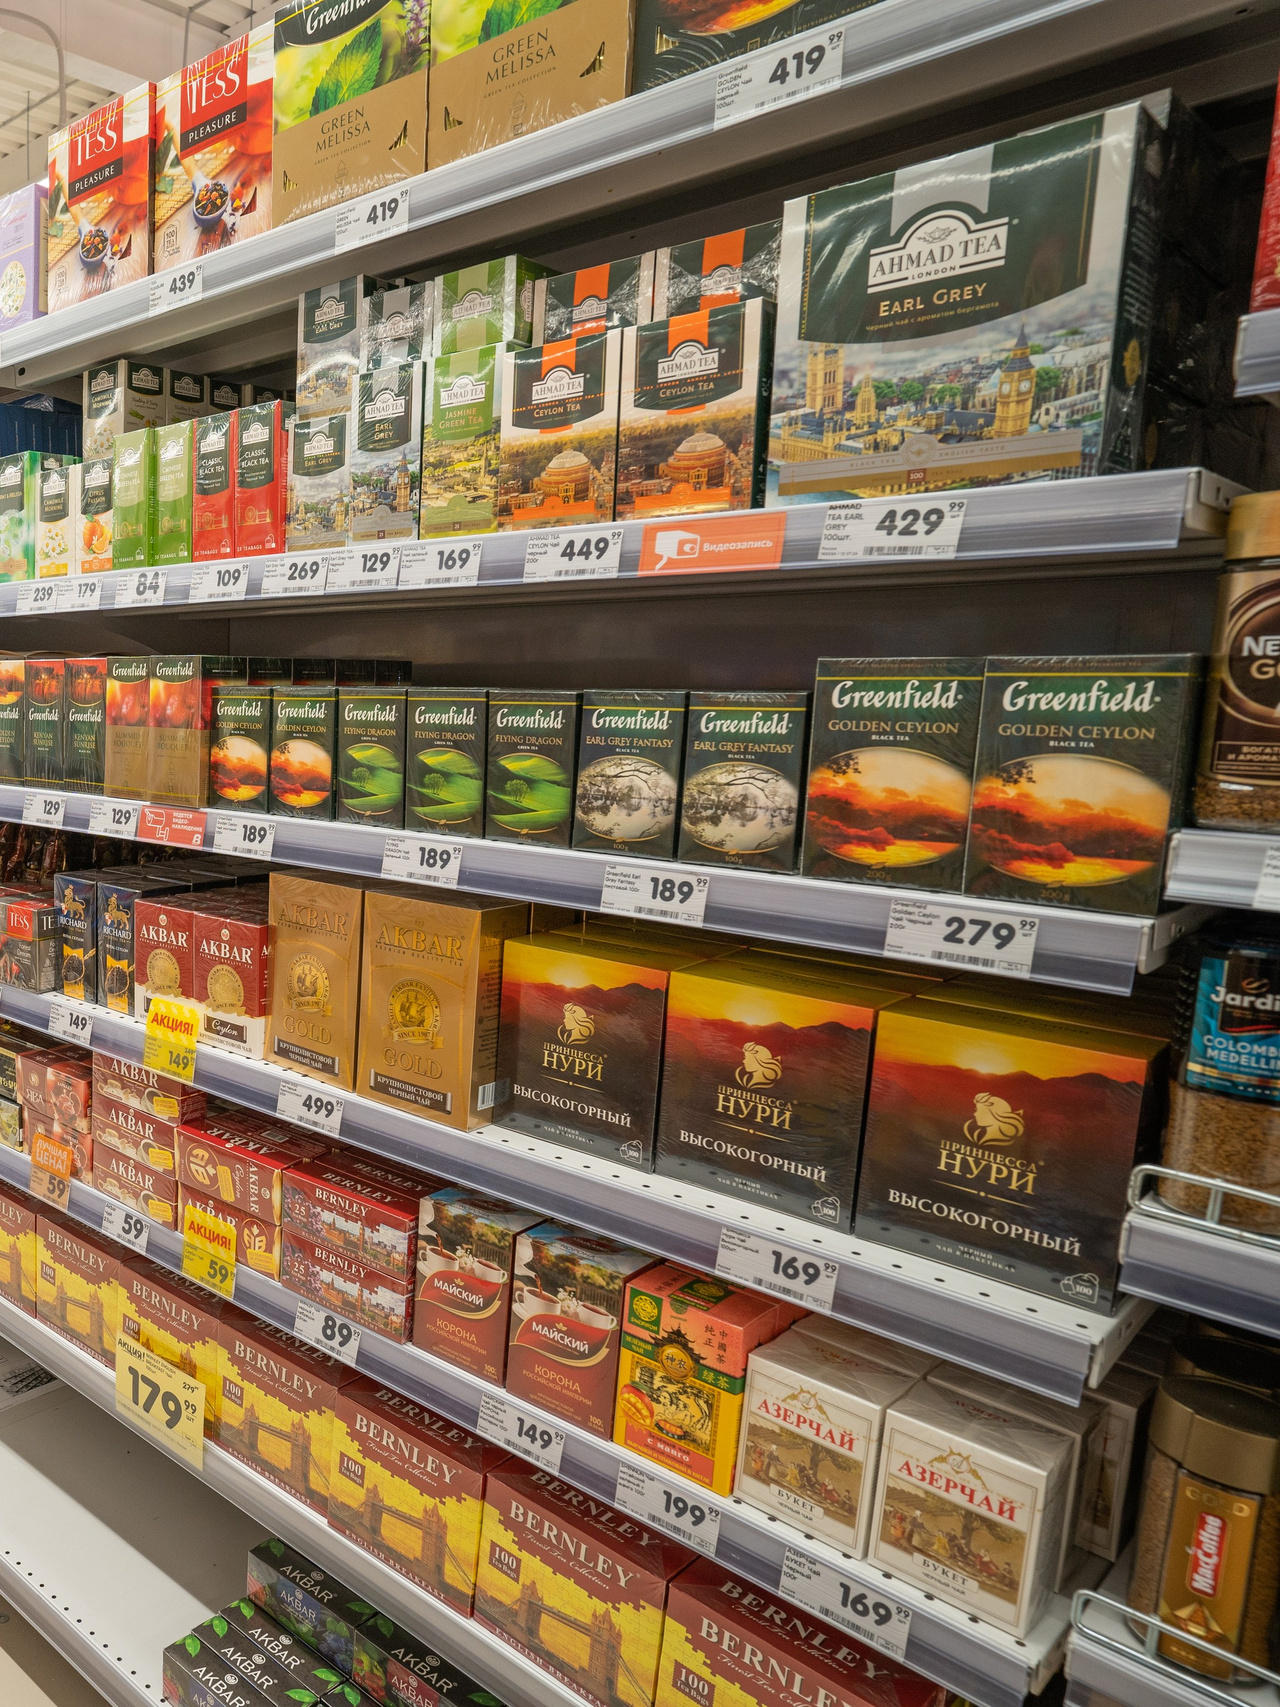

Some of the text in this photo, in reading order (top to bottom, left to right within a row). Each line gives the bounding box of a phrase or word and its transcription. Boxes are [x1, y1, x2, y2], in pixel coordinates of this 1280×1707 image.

[493, 27, 550, 64] GREEN
[769, 31, 843, 85] 419 99
[485, 44, 557, 85] MELISSA
[189, 111, 238, 144] PLEASURE
[75, 165, 115, 193] PLEASURE
[366, 189, 409, 226] 419 99
[873, 234, 1002, 279] AHMAD TEA
[169, 270, 195, 296] 439
[911, 265, 957, 281] LONDON
[444, 407, 478, 419] JASMINE
[375, 422, 393, 432] EARL
[827, 512, 864, 522] TEA EARL
[828, 502, 862, 511] AHMAD
[875, 501, 965, 537] 429 99
[825, 523, 848, 532] GREY
[437, 543, 482, 571] 169 99
[560, 530, 622, 562] 449 99
[702, 538, 774, 555] Видеозапись
[288, 556, 329, 581] 269 99
[361, 547, 401, 573] 129 99
[136, 571, 161, 596] 84
[216, 567, 242, 588] 109
[32, 586, 54, 603] 239
[831, 680, 959, 710] Greenfield
[1002, 680, 1156, 713] Greenfield
[215, 721, 263, 731] GOLDEN CEYLON
[276, 725, 327, 734] GOLDEN CEYLON
[496, 708, 562, 730] Greenfield
[700, 711, 790, 736] Greenfield
[828, 719, 960, 735] GOLDEN CEYLON
[998, 723, 1156, 740] GOLDEN CEYLON
[33, 732, 53, 740] KENYAN
[73, 741, 97, 750] SUNRISE
[74, 734, 96, 742] KENYAN
[414, 730, 476, 742] FLYING DRAGON
[496, 734, 563, 747] FLYING DRAGON
[694, 741, 794, 755] EARL GREY FANTASY
[871, 734, 895, 742] BLACK
[1049, 740, 1076, 748] BLACK
[43, 799, 60, 816] 129
[111, 808, 132, 826] 129
[242, 824, 267, 844] 189
[269, 824, 276, 832] 99
[419, 847, 462, 870] 189 99
[650, 877, 708, 904] 189 99
[9, 911, 30, 930] TESS
[60, 916, 88, 930] RICHARD
[943, 916, 1037, 951] 279 99
[140, 925, 187, 948] AKBAR
[375, 924, 463, 961] AKBAR
[200, 942, 252, 964] AKBAR
[151, 1013, 194, 1036] АКЦИЯ!
[211, 1018, 239, 1037] Ceylon
[282, 1015, 332, 1045] GOLD
[169, 1050, 190, 1071] 149
[279, 1041, 333, 1066] КРУПНОЛИСТОВОЙ
[383, 1047, 443, 1080] GOLD
[542, 1050, 604, 1082] НУРИ
[543, 1042, 604, 1064] ПРИНЦЕССА
[377, 1075, 444, 1102] КРУПНОЛИСТОВОЙ
[388, 1087, 431, 1107] ЧЕРНЫЙ ЧАЙ
[718, 1085, 794, 1112] ПРИНЦЕССА
[302, 1096, 344, 1119] 499 99
[513, 1083, 632, 1128] ВЫСОКОГОРНЫЙ
[716, 1093, 793, 1131] НУРИ
[679, 1129, 827, 1183] ВЫСОКОГОРНЫЙ
[940, 1139, 1037, 1174] ПРИНЦЕССА
[937, 1148, 1037, 1196] НУРИ
[294, 1204, 307, 1217] 25
[888, 1188, 1082, 1258] ВЫСОКОГОРНЫЙ
[122, 1213, 145, 1240] 59
[207, 1259, 230, 1284] 59
[771, 1250, 837, 1286] 169 99
[433, 1278, 484, 1308] МАЙСКИЙ
[132, 1280, 203, 1333] BERNLEY
[321, 1316, 361, 1349] 89 99
[436, 1318, 477, 1344] КОРОНА
[532, 1321, 590, 1355] МАЙСКИЙ
[534, 1364, 582, 1393] КОРОНА
[128, 1365, 197, 1431] 179 99
[517, 1417, 565, 1450] 149 99
[757, 1398, 856, 1454] АЗЕРЧАЙ
[354, 1414, 461, 1485] BERNLEY
[777, 1489, 817, 1514] БУКЕТ
[898, 1459, 1018, 1524] АЗЕРЧАЙ
[662, 1489, 720, 1528] 199 99
[509, 1499, 635, 1590] BERNLEY
[494, 1546, 517, 1571] 100
[921, 1558, 969, 1587] БУКЕТ
[839, 1582, 911, 1627] 169 99
[678, 1668, 709, 1697] 100
